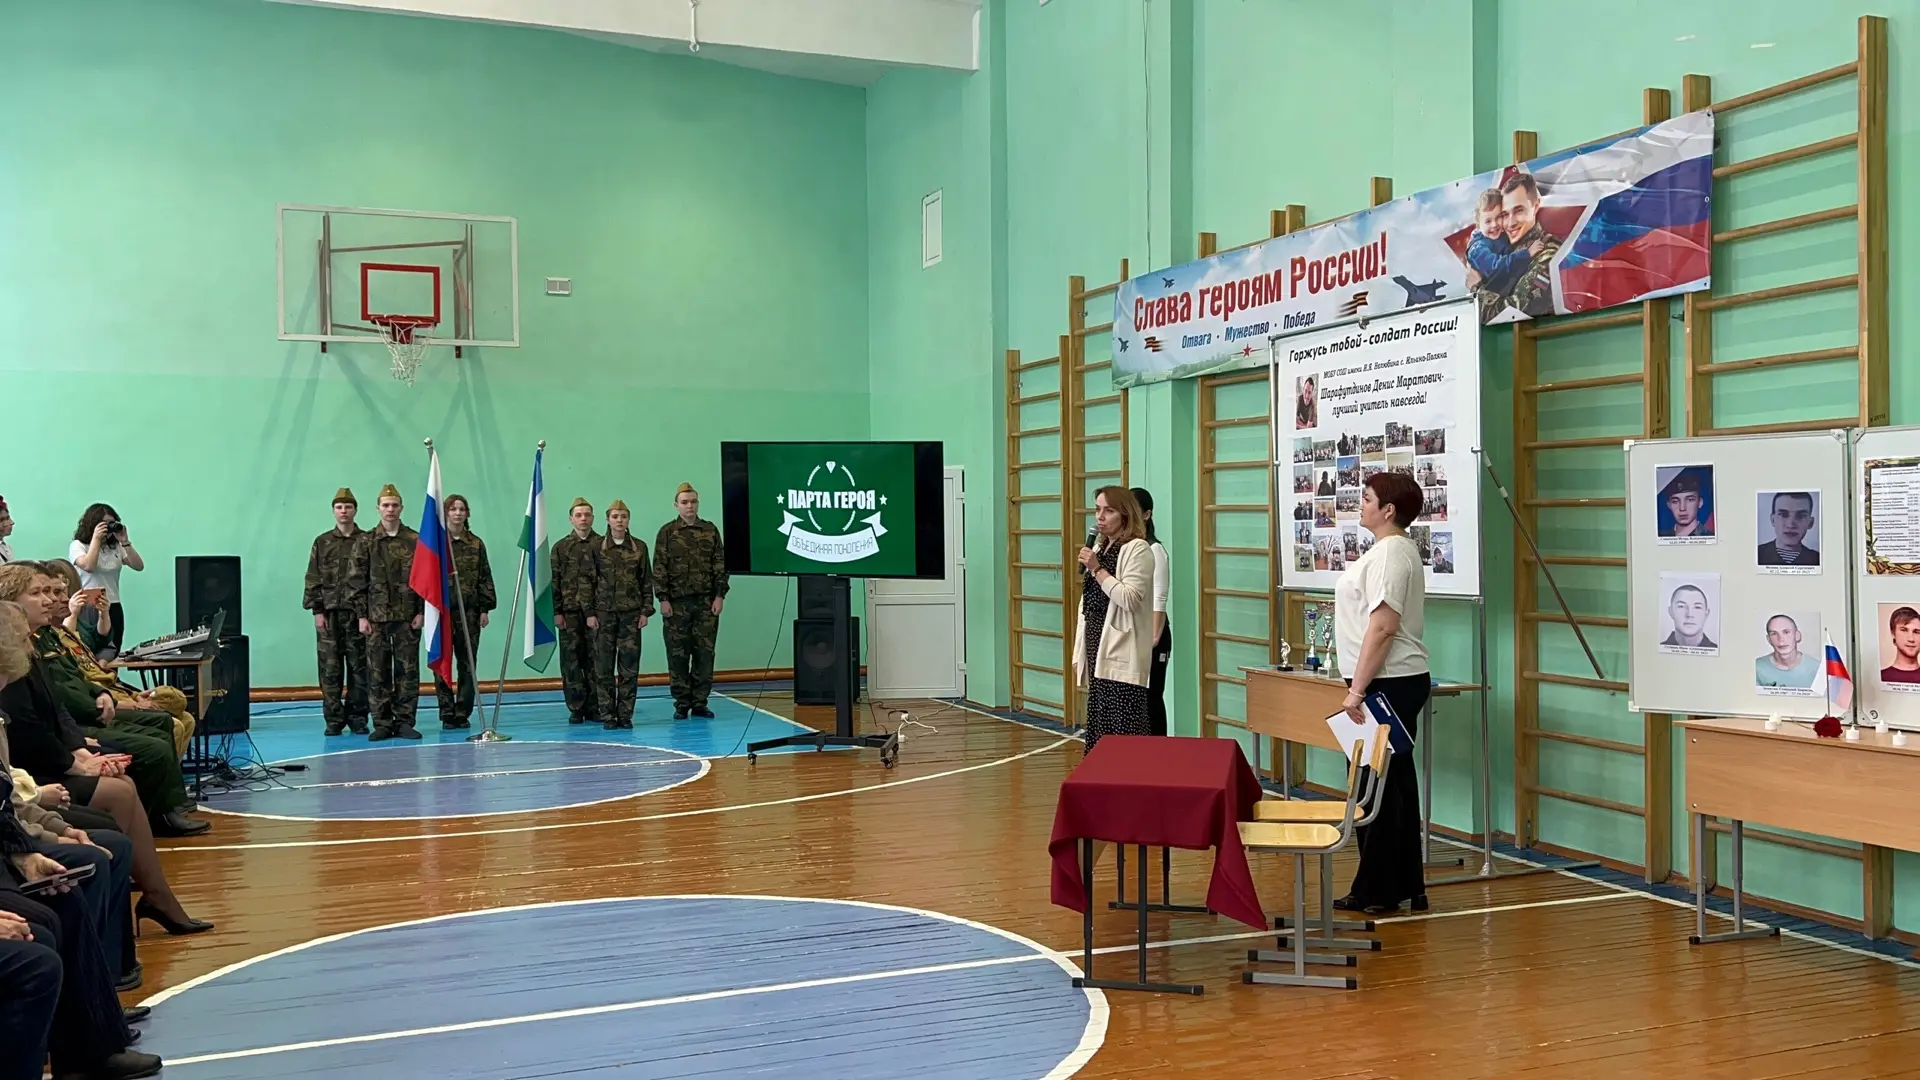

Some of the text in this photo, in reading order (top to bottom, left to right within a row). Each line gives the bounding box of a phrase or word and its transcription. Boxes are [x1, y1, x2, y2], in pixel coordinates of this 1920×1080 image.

[1134, 231, 1387, 332] Слава героям России!
[1181, 311, 1316, 349] Отвага Мужество Победа
[1289, 346, 1328, 364] Горжусь
[1413, 316, 1459, 337] России!
[1321, 383, 1372, 400] Шарафутдинов
[1372, 379, 1395, 394] Денис
[1332, 392, 1427, 416] лучший учитель навсегда!
[788, 489, 876, 510] ПАРТА ГЕРОЯ
[791, 535, 874, 555] ОБЪЕДИНЯЯ ПОКОЛЕНИЯ
